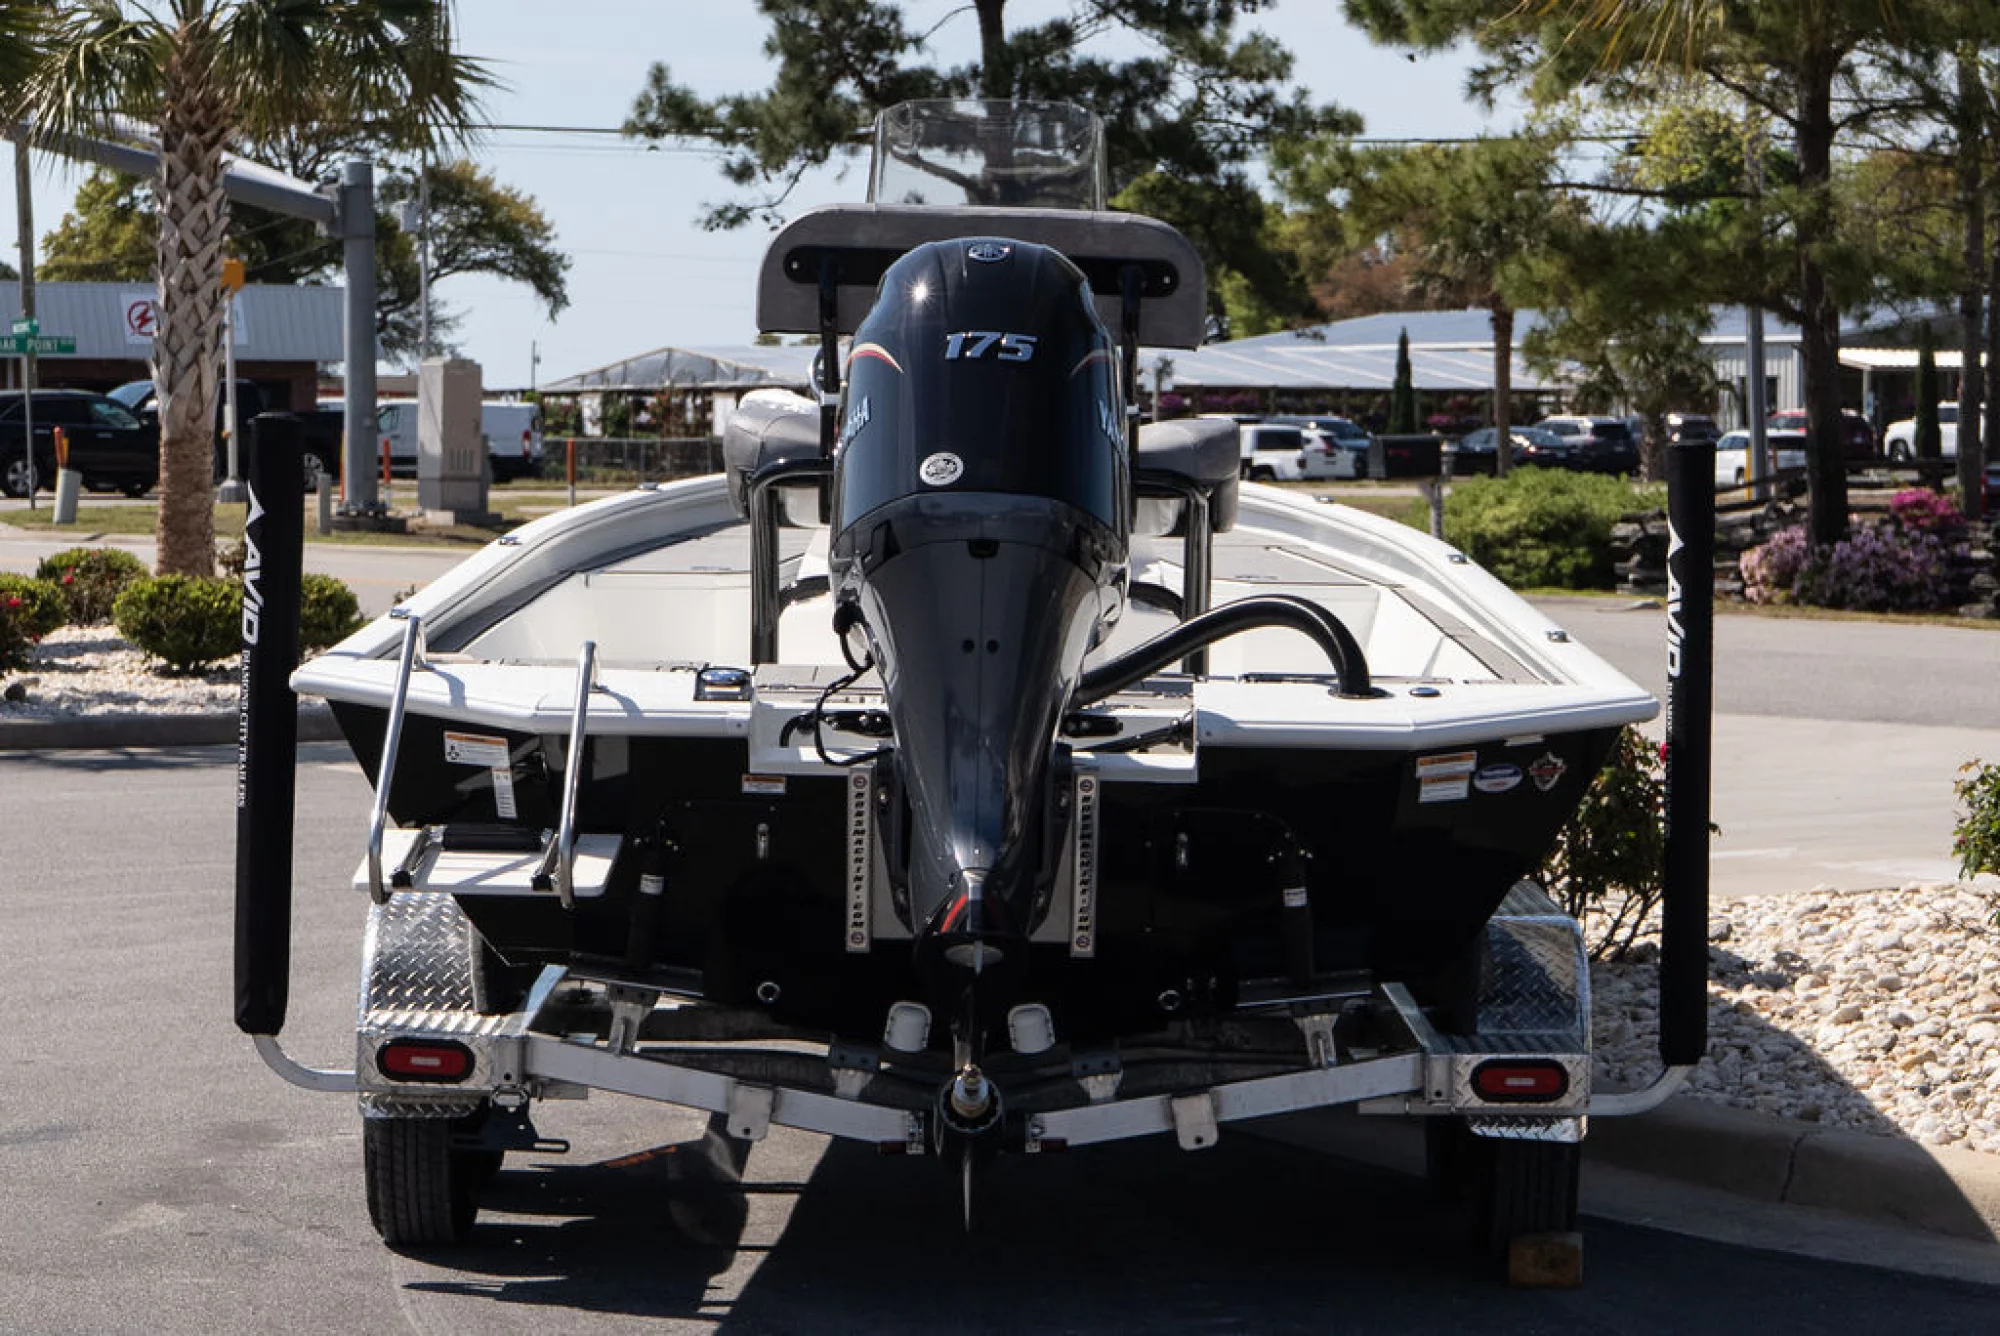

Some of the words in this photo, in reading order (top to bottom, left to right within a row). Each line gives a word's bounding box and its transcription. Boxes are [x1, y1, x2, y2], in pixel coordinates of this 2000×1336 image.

[27, 338, 58, 352] POINT
[945, 331, 1037, 361] 175
[242, 531, 265, 645] AVID
[1667, 564, 1686, 677] AVID
